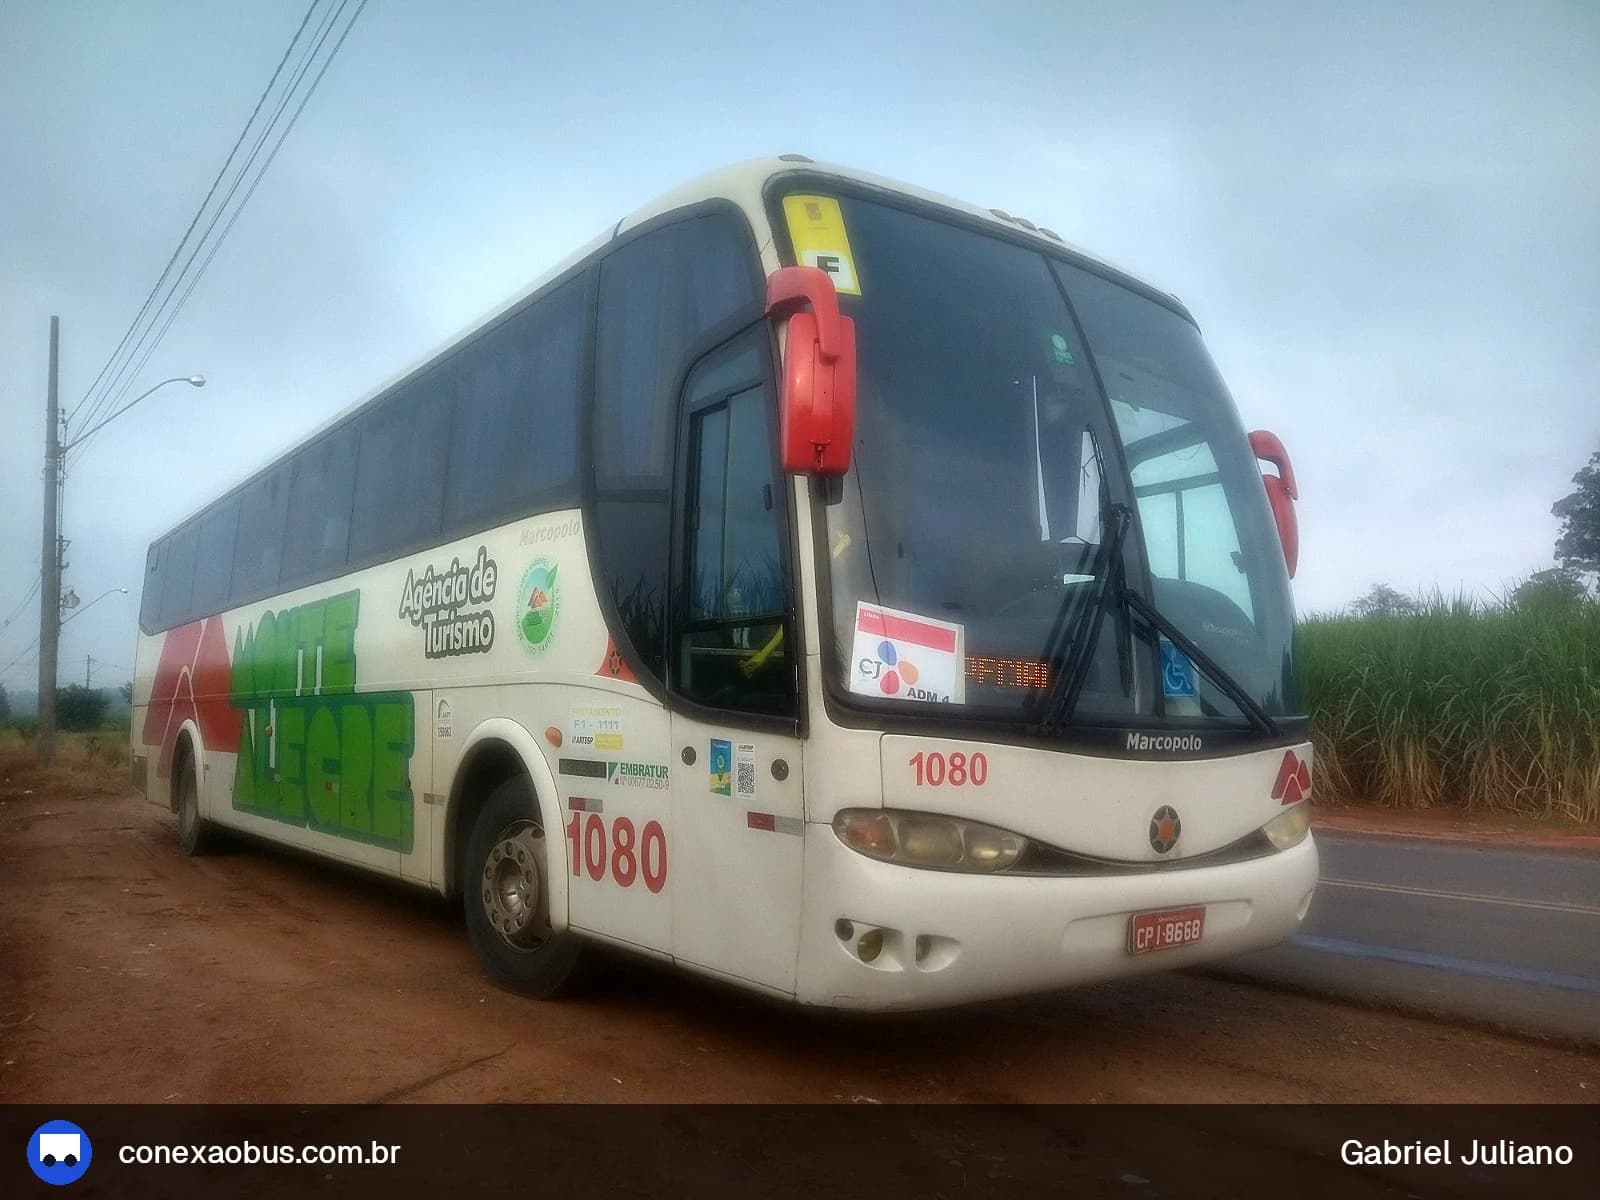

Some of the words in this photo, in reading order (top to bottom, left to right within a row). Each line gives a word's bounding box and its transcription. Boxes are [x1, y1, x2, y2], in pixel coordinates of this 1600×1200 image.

[520, 519, 580, 546] Marcopolo
[399, 557, 470, 625] Agência
[470, 546, 497, 605] de
[423, 609, 495, 658] Turismo
[859, 658, 883, 679] CJ
[907, 687, 938, 704] ADM
[1126, 733, 1202, 752] Marcopolo
[620, 762, 669, 779] EMBRATUR
[909, 752, 988, 786] 1080
[567, 812, 668, 893] 1080
